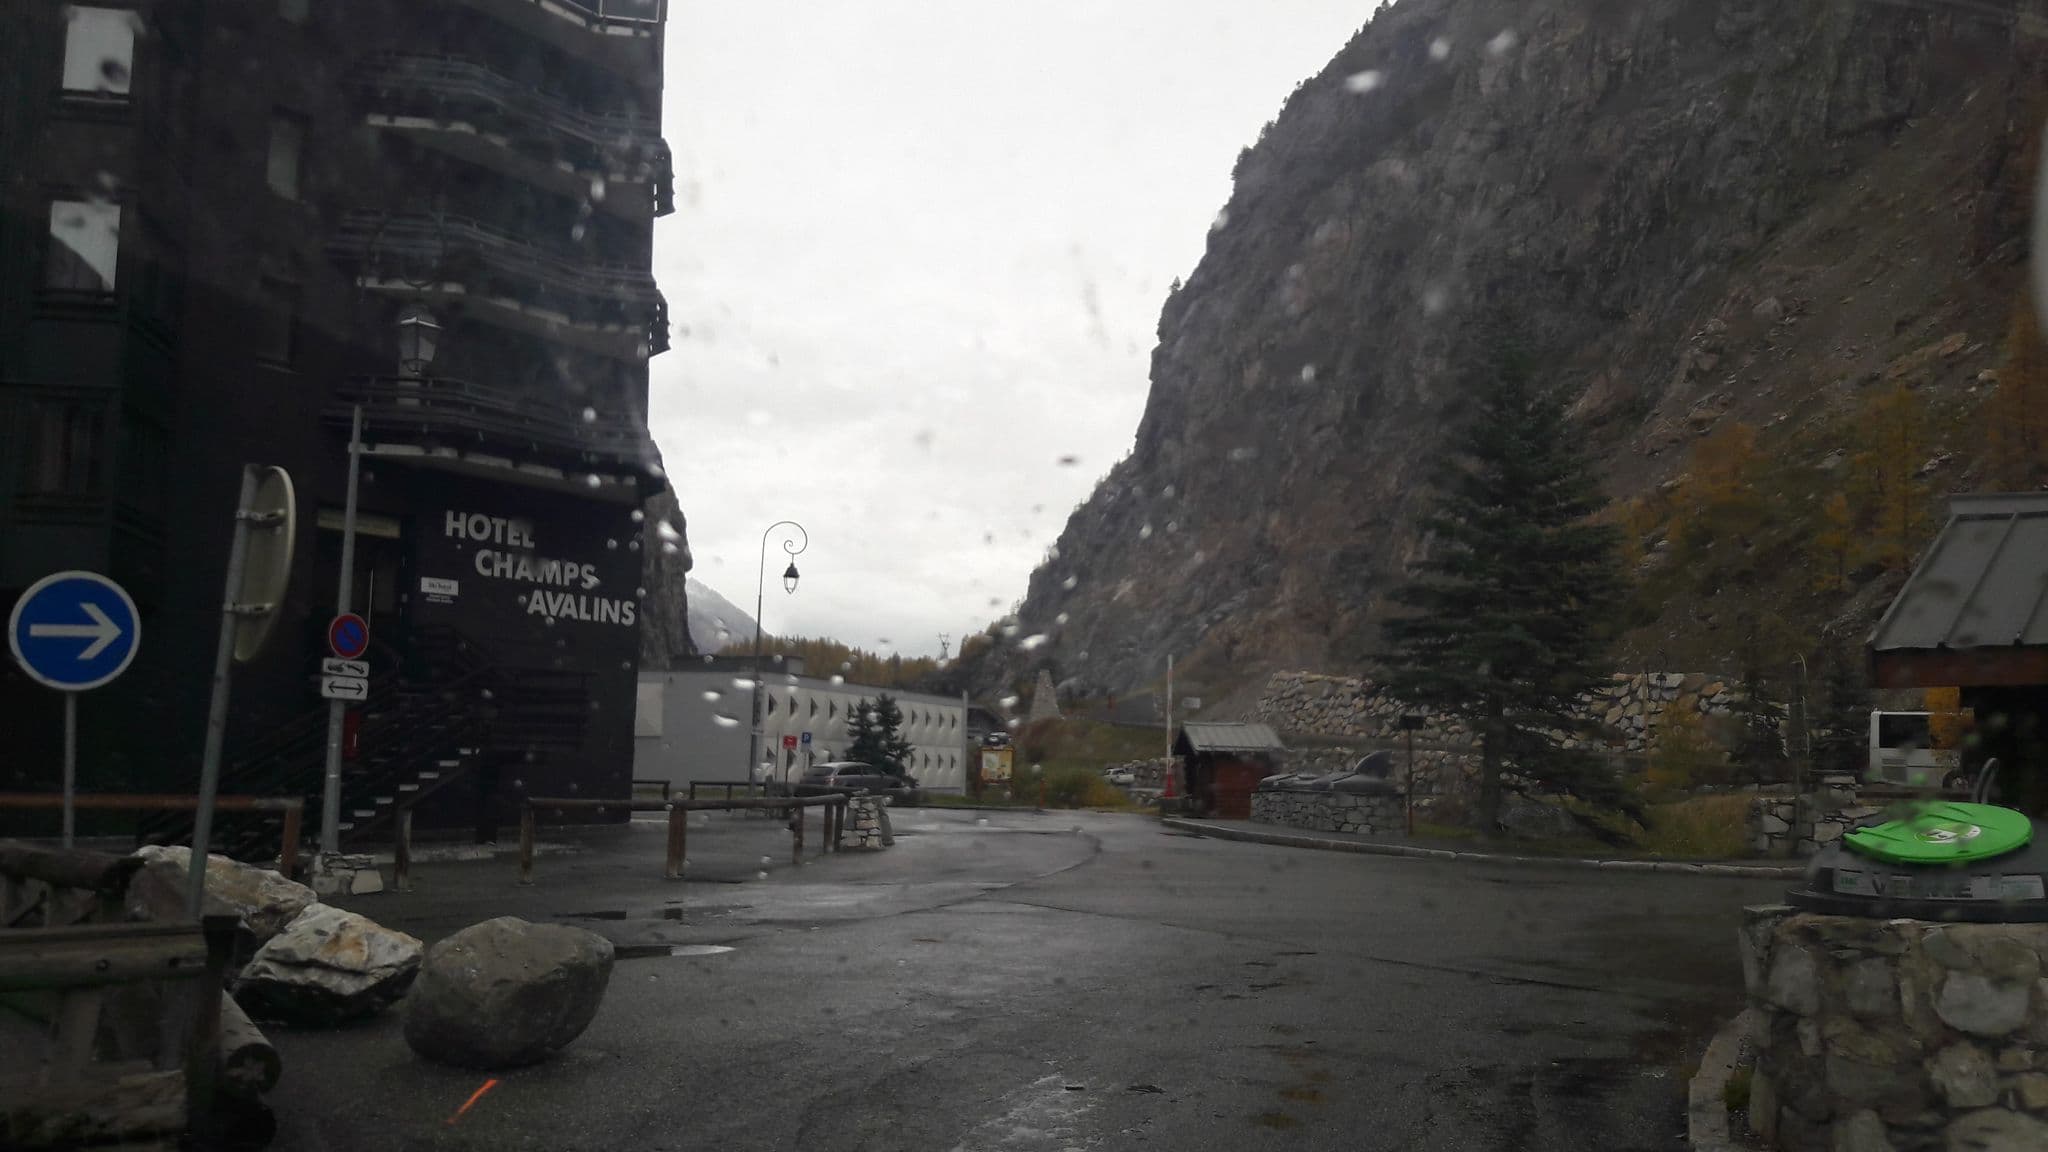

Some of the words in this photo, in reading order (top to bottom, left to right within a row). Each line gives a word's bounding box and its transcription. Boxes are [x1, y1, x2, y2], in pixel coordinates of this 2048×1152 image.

[446, 510, 535, 548] HOTEL
[475, 549, 597, 589] CHAMPS
[527, 589, 636, 626] AVALINS
